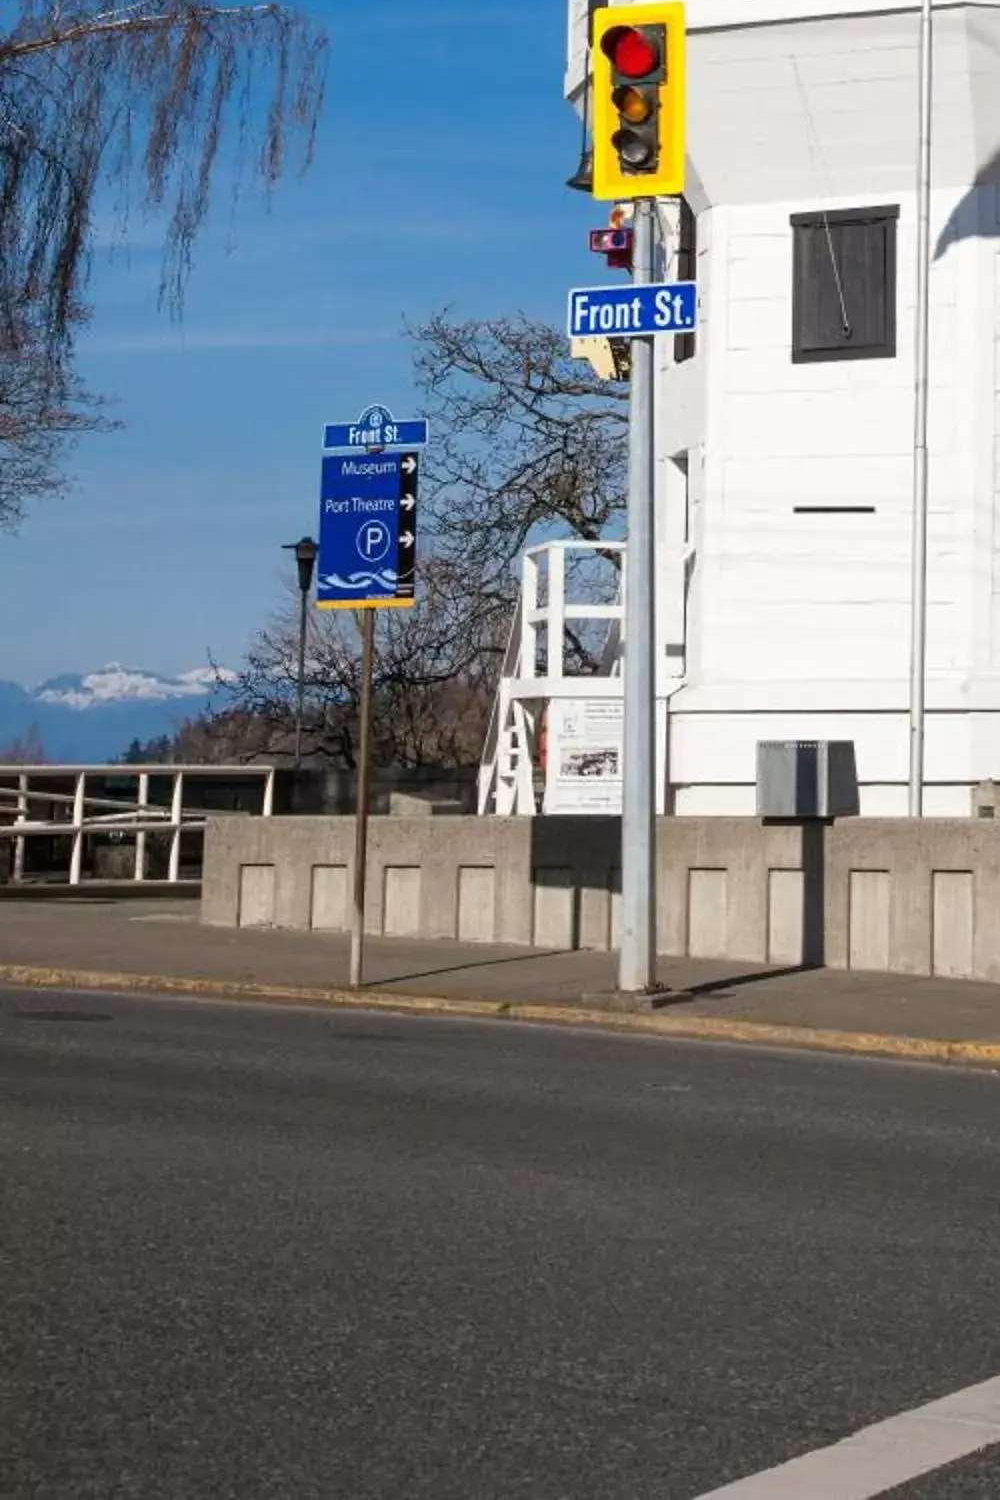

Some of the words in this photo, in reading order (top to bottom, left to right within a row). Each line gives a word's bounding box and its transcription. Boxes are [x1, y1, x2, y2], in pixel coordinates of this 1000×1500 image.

[575, 295, 641, 331] Front
[654, 289, 691, 327] St.
[349, 426, 381, 445] Front
[341, 461, 397, 476] Museum
[325, 499, 349, 513] Port
[352, 497, 395, 512] Theatre
[366, 528, 383, 554] P
